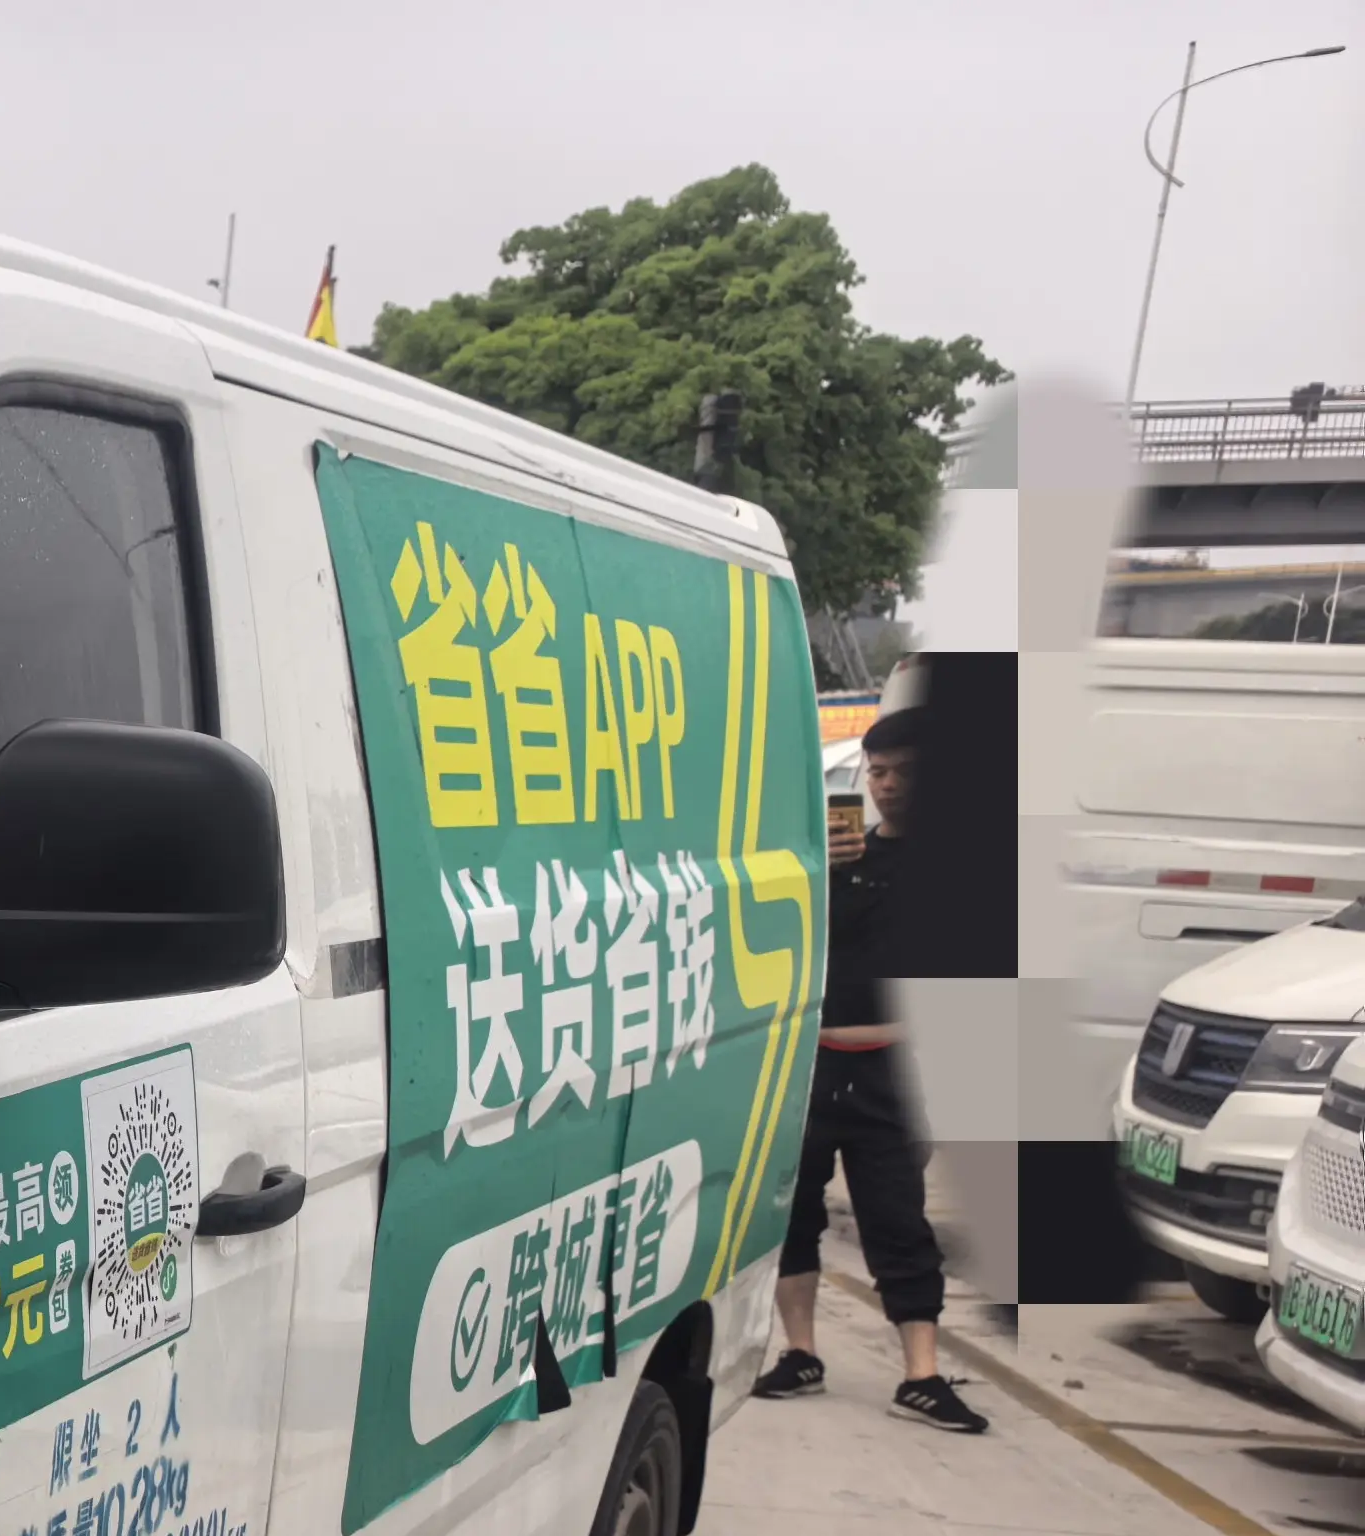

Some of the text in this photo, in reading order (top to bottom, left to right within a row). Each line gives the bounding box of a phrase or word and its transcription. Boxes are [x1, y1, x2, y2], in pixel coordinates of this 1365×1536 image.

[390, 520, 685, 828] 省省APP
[440, 849, 715, 1161] 送货省钱
[128, 1174, 163, 1232] 省省
